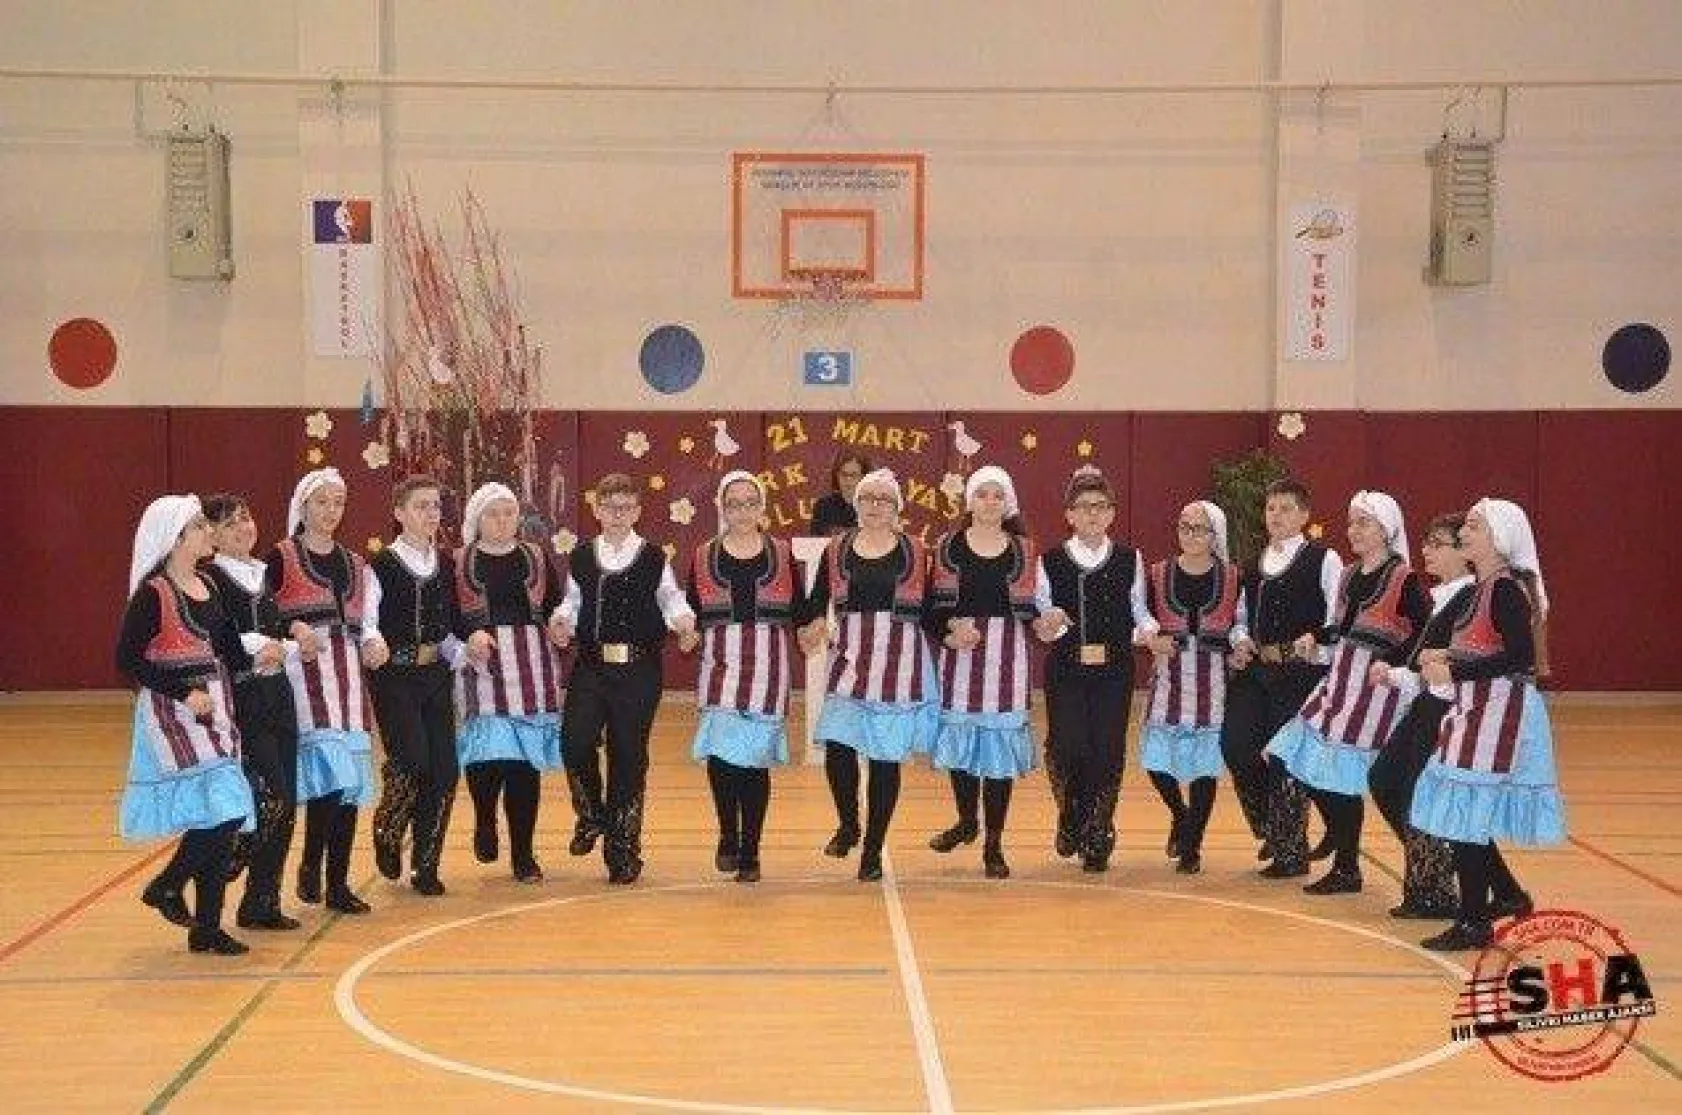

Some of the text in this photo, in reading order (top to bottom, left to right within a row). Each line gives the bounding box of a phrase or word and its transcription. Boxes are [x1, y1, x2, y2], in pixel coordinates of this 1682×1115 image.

[816, 354, 839, 382] 3
[767, 416, 930, 454] 21 MART
